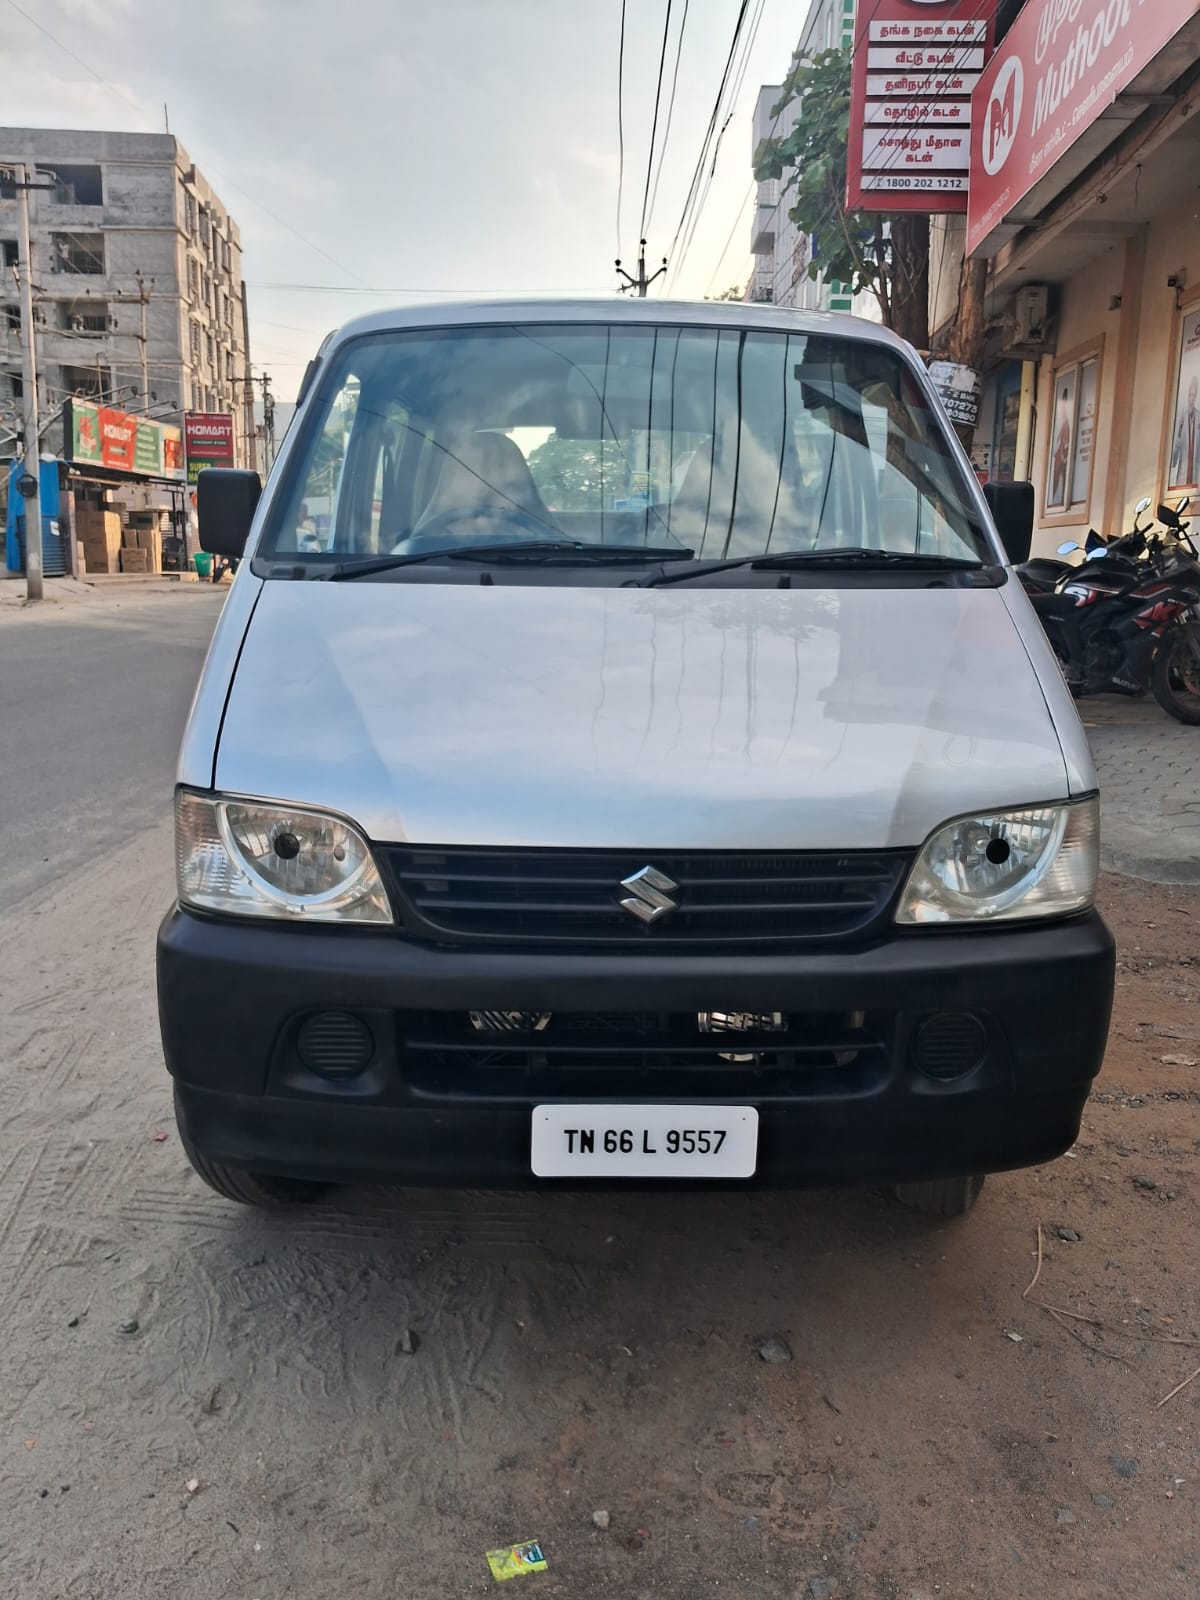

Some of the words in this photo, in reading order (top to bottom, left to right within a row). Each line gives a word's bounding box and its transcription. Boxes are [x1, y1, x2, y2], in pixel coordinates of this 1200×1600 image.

[932, 106, 960, 117] கடன்
[905, 151, 934, 163] கடன்
[887, 178, 911, 188] 1800
[914, 178, 933, 188] 202
[937, 178, 962, 188] 1212
[187, 425, 232, 436] HOMART
[564, 1129, 595, 1154] TN
[603, 1129, 634, 1154] 66
[642, 1129, 657, 1154] L
[666, 1130, 727, 1154] 9557
